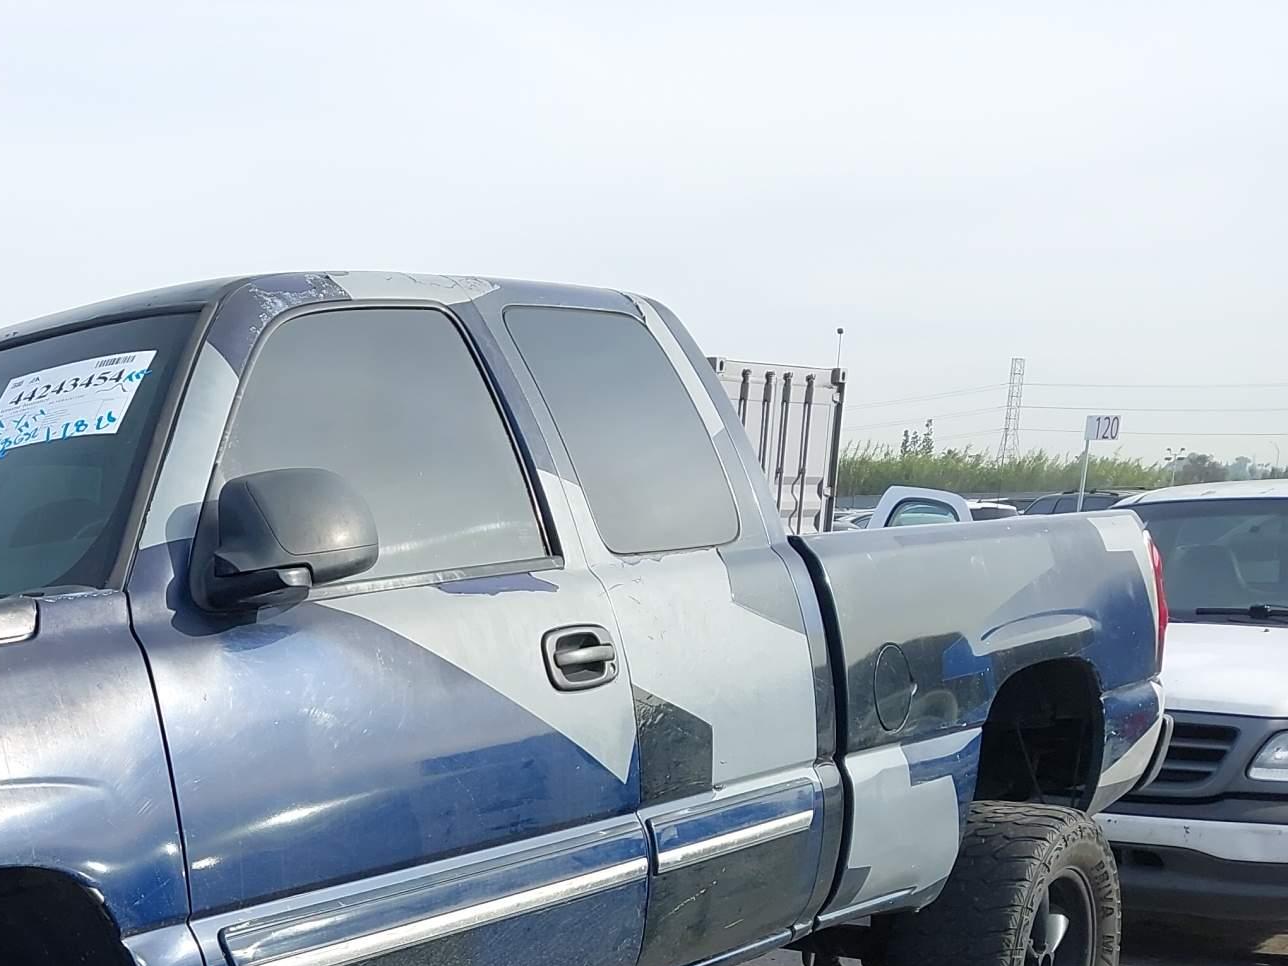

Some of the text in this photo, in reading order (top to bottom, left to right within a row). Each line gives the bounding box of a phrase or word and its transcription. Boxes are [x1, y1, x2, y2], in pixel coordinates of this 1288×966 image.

[9, 369, 125, 405] 44243454
[1096, 416, 1119, 440] 120
[1094, 860, 1114, 918] PRIVA
